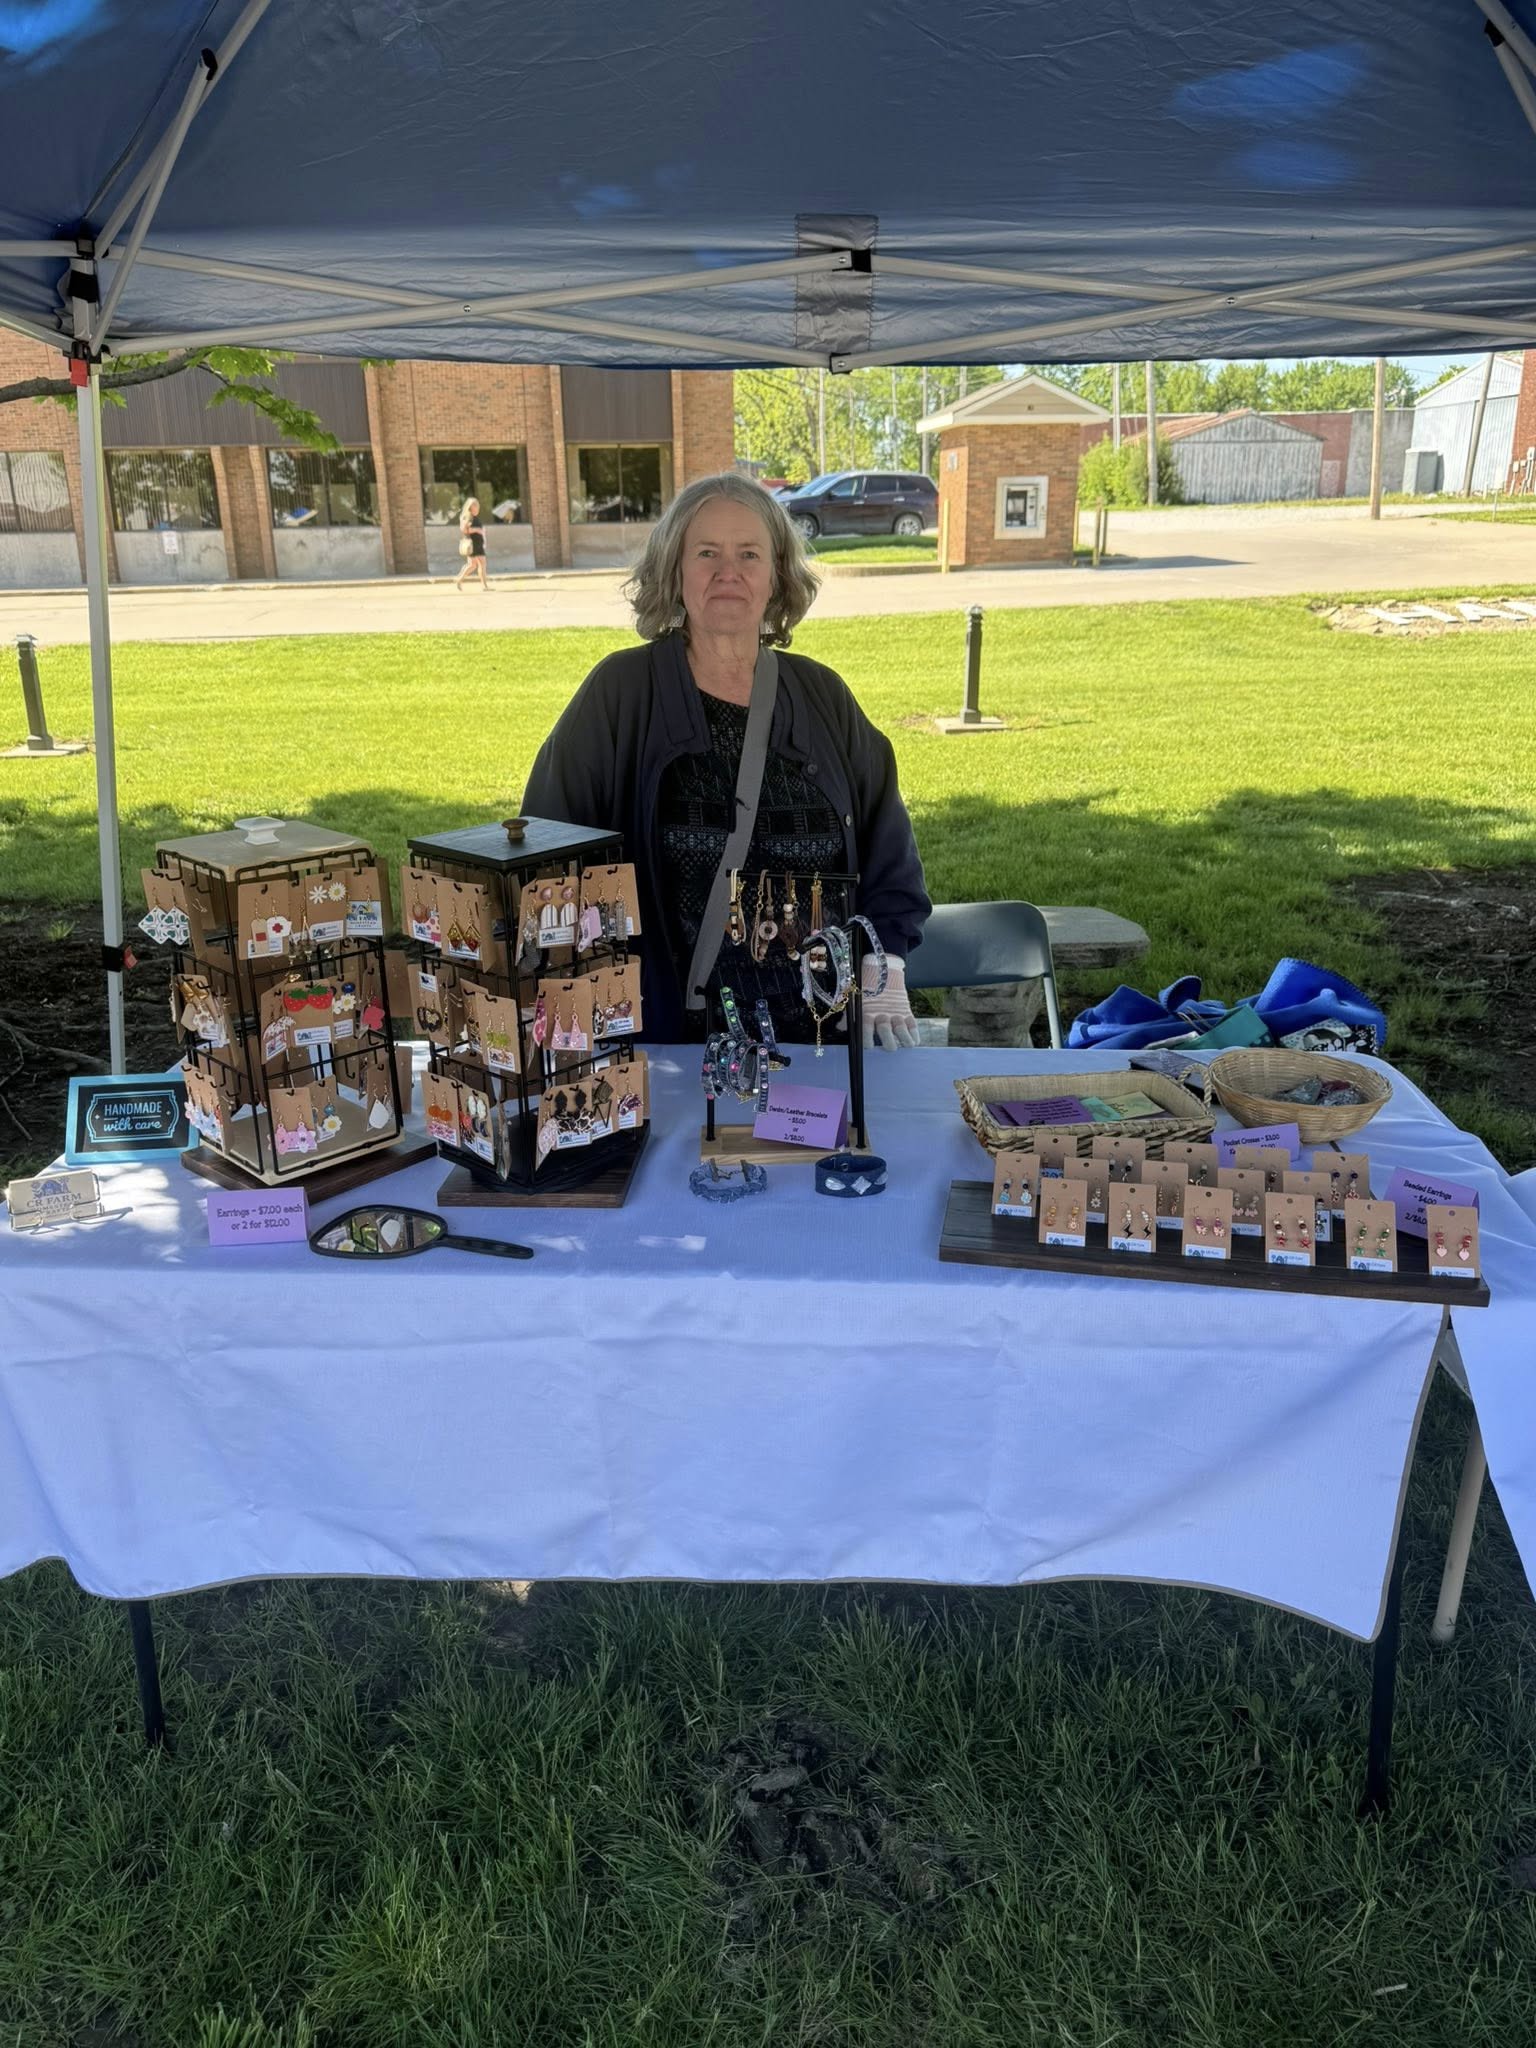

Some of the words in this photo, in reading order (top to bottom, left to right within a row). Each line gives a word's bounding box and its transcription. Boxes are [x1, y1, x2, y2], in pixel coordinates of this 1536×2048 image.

[104, 1101, 162, 1116] HANDMADE
[769, 1105, 805, 1116] Denim/Leather
[806, 1110, 828, 1119] Bracelets
[103, 1116, 133, 1131] with
[135, 1120, 162, 1130] care
[1223, 1139, 1240, 1147] Pocket
[1403, 1180, 1427, 1193] Beaded
[1427, 1186, 1452, 1201] Earrings
[26, 1199, 43, 1208] CR
[48, 1192, 82, 1205] FARM
[217, 1208, 250, 1219] Earrings
[258, 1205, 281, 1216] $7.00
[283, 1203, 303, 1214] each
[231, 1222, 241, 1231] or
[242, 1221, 248, 1230] 2
[249, 1220, 262, 1229] for
[264, 1218, 290, 1229] $12.00
